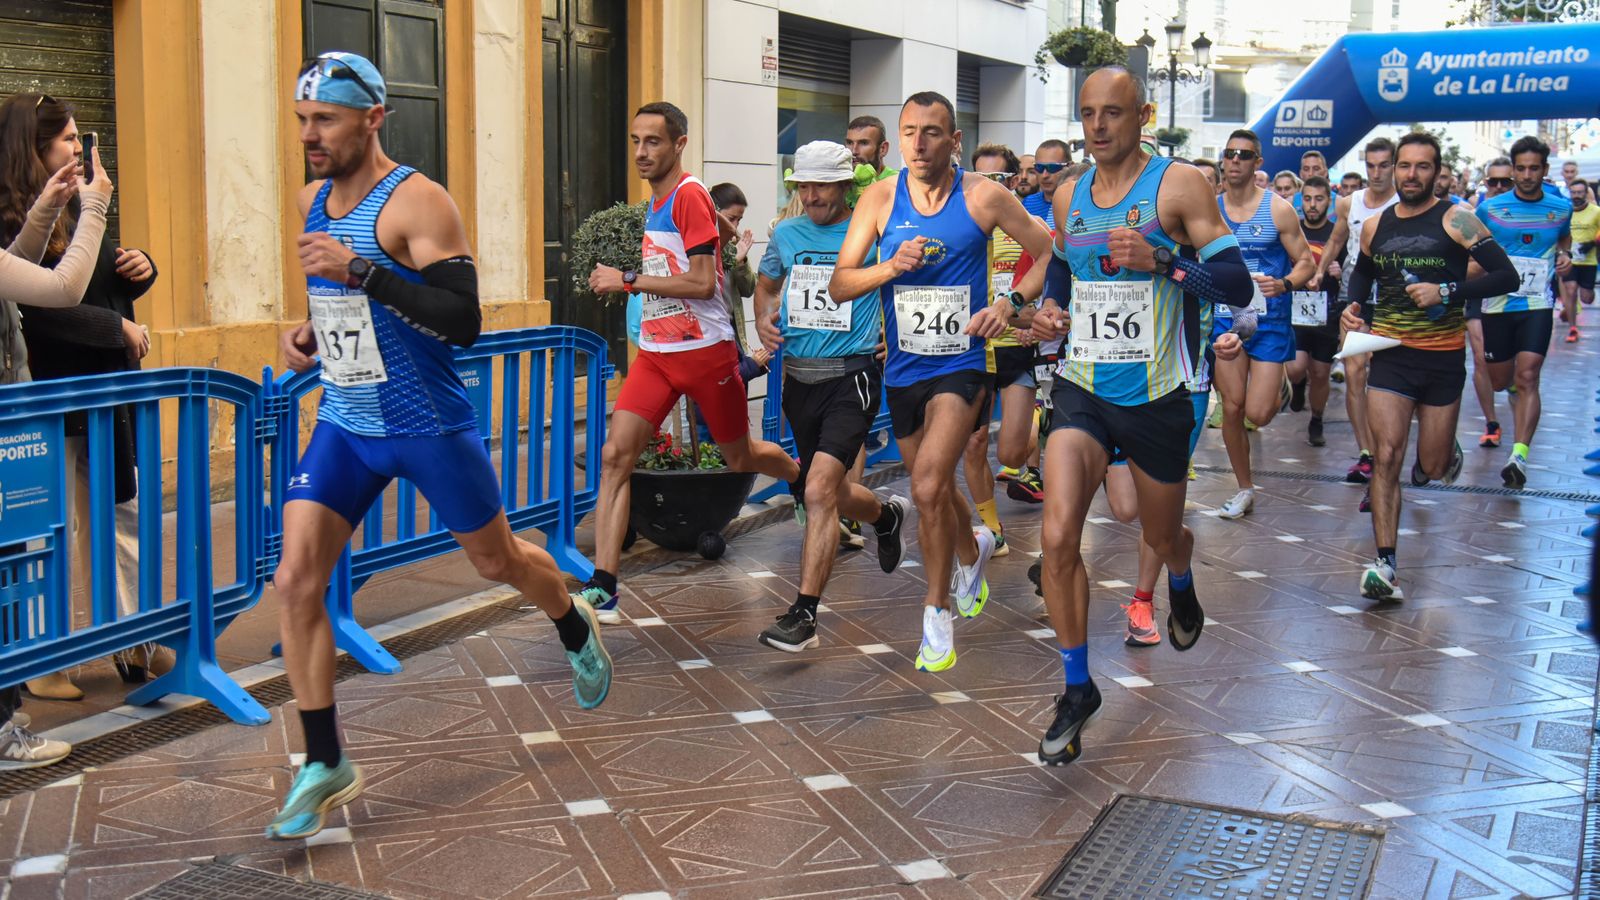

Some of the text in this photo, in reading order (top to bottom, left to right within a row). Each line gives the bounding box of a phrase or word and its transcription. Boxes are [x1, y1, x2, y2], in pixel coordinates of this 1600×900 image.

[1415, 46, 1590, 74] Ayuntamiento
[1433, 73, 1570, 96] de La Línea
[1282, 107, 1296, 121] D
[1272, 136, 1331, 147] DEPORTES
[1403, 257, 1446, 267] TRAINING
[1301, 304, 1317, 317] 83
[912, 311, 960, 335] 246
[1088, 311, 1141, 340] 156
[320, 329, 360, 361] 137
[32, 432, 42, 440] DE
